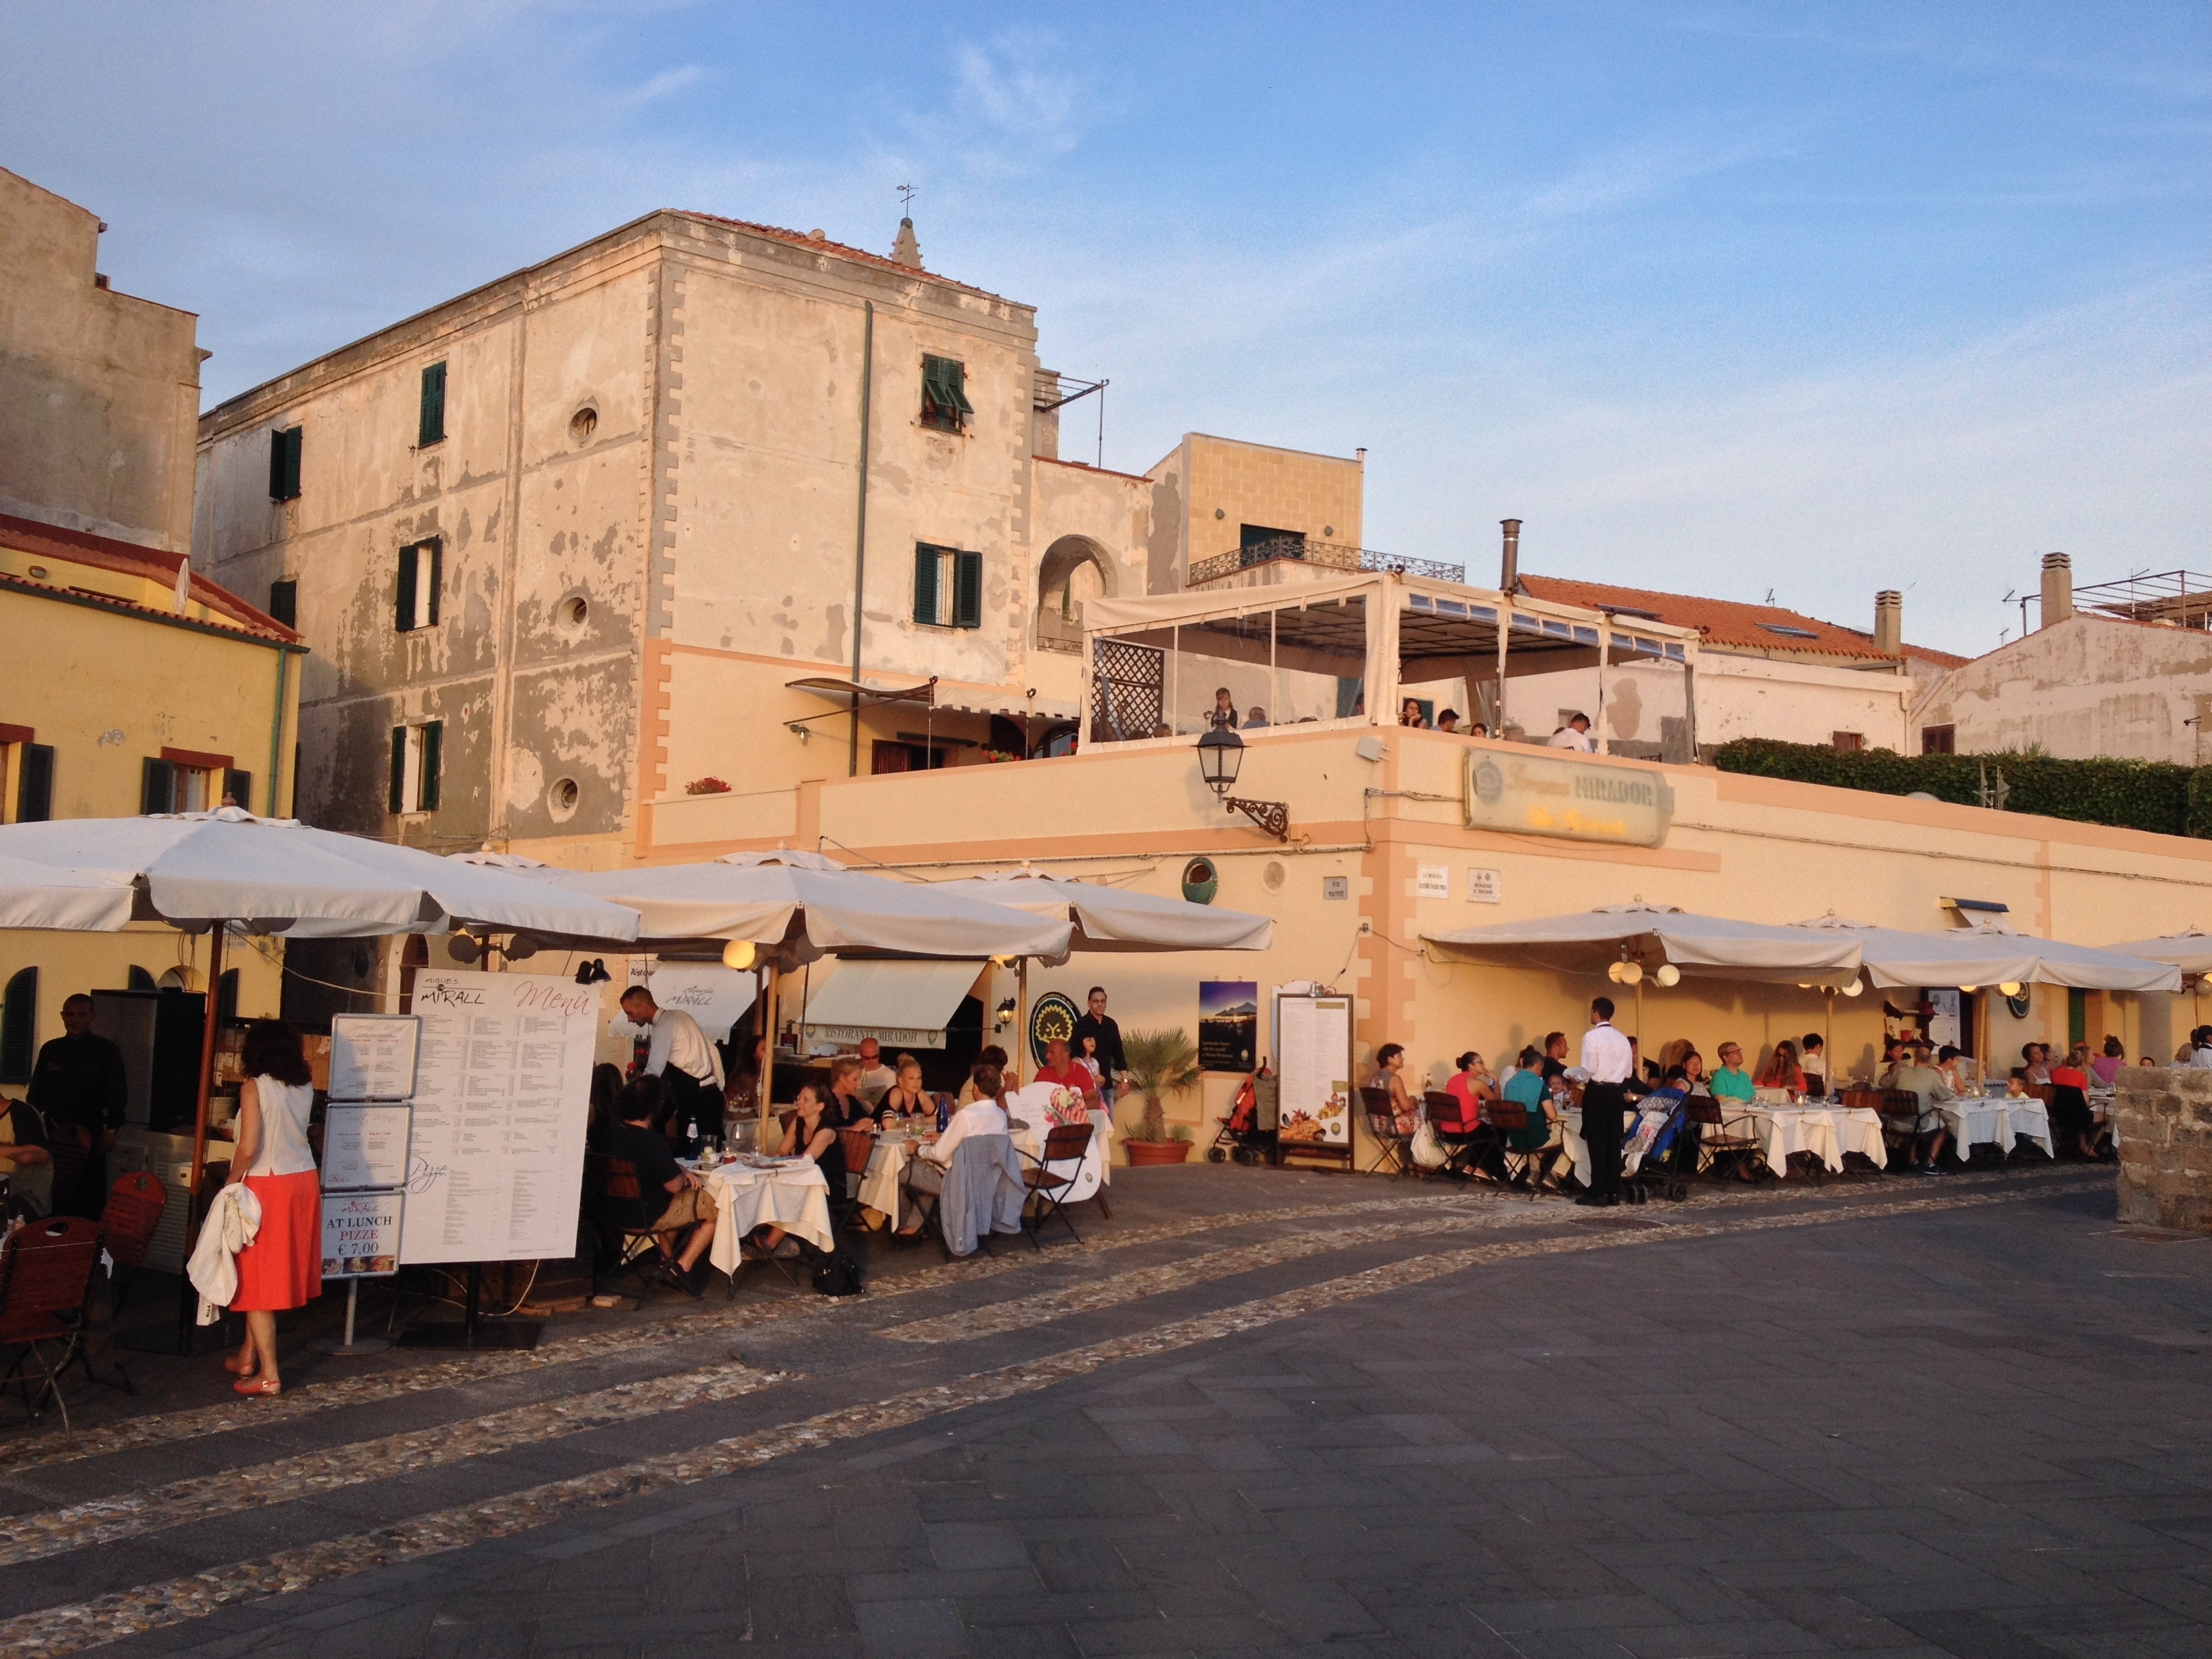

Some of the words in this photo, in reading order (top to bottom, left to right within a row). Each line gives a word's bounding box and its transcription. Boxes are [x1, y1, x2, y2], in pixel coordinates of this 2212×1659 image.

[1574, 775, 1652, 806] MIRADOR
[420, 989, 485, 1007] MIRALL
[514, 980, 592, 1017] Menù
[825, 1027, 874, 1040] RISTORANTE
[878, 1030, 917, 1043] MIRADOR
[326, 1218, 344, 1229] AT
[348, 1216, 392, 1227] LUNCH
[340, 1229, 378, 1241] PIZZE
[338, 1244, 346, 1256] €
[351, 1242, 379, 1255] 7,00
